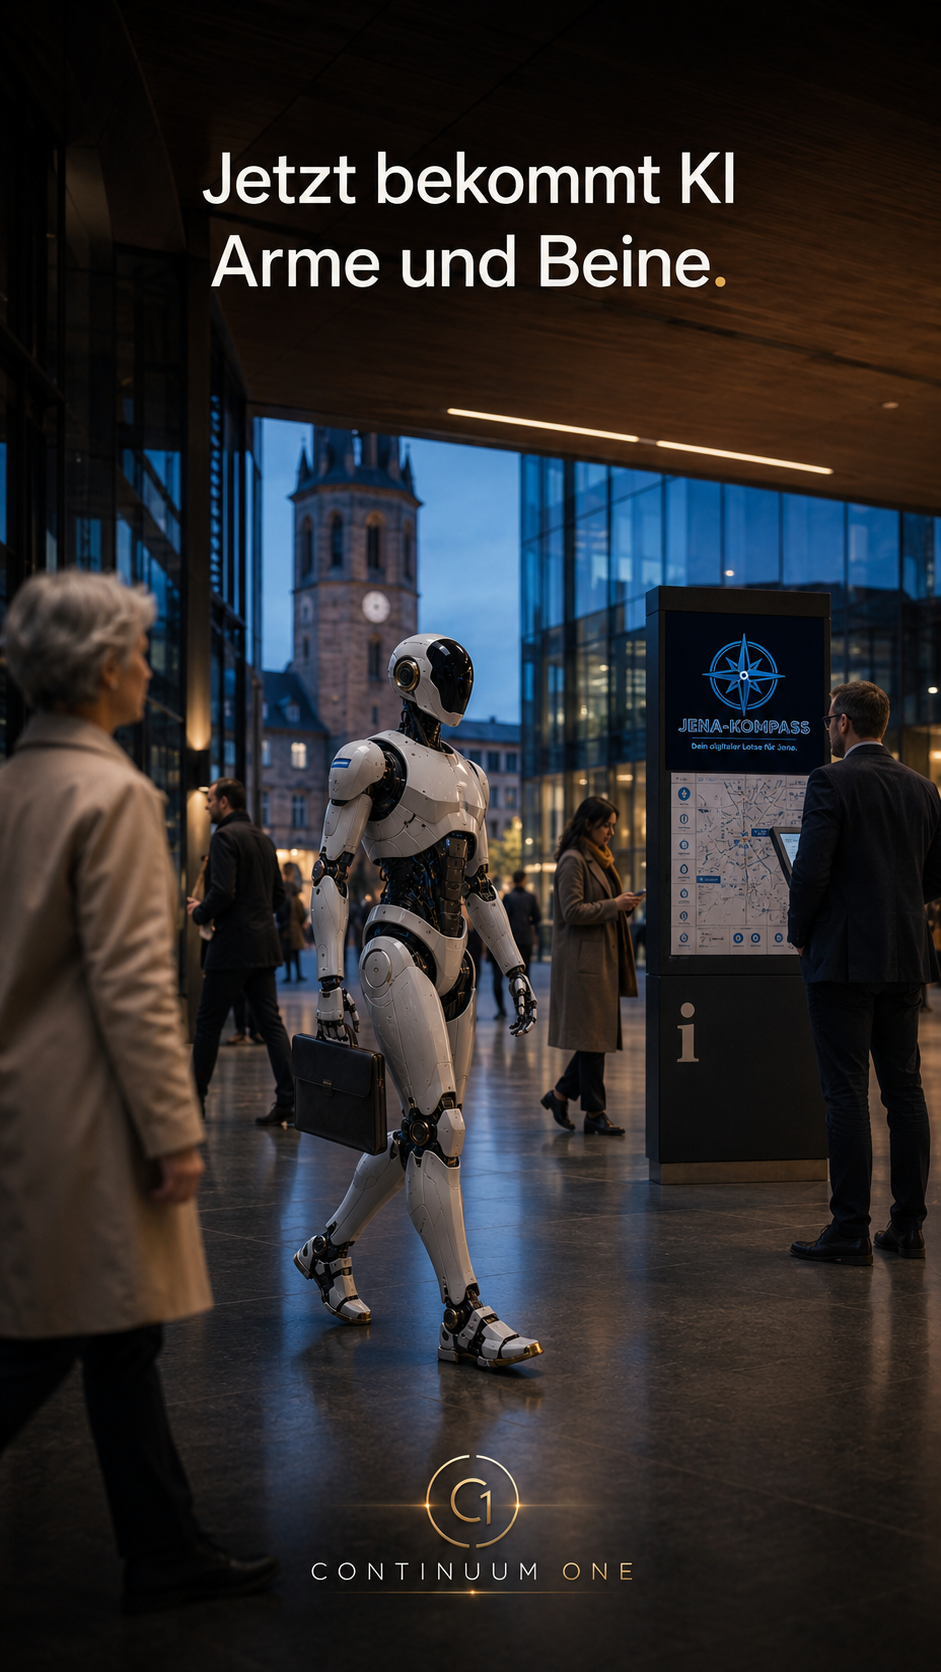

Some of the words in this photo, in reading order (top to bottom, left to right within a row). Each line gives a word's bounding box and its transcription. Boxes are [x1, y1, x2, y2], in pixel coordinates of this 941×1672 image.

[678, 718, 811, 735] JENA-KOMPASS
[691, 742, 708, 750] Dein
[742, 743, 763, 751] Lotse
[764, 743, 776, 751] für
[677, 1002, 699, 1063] i
